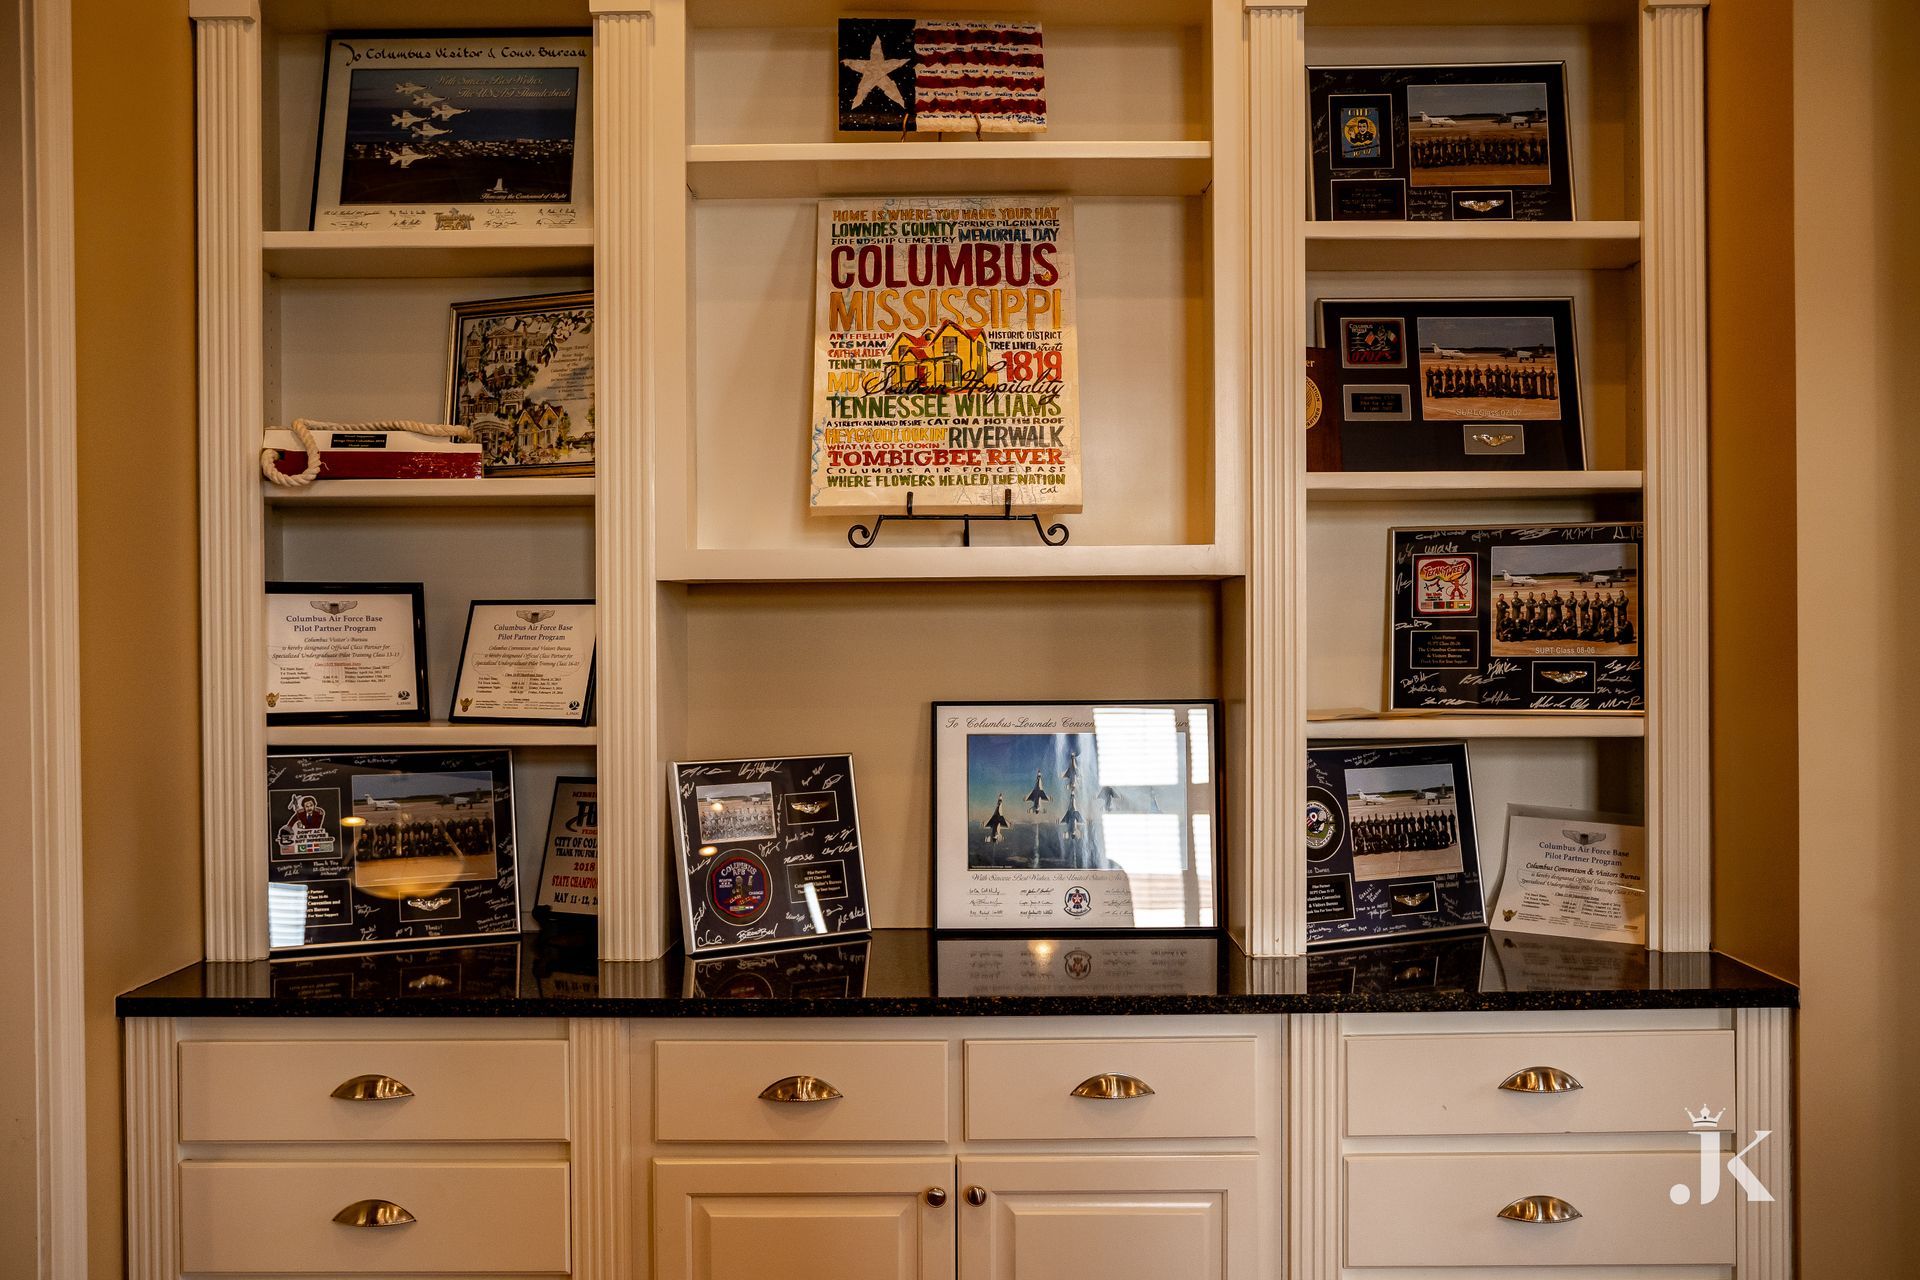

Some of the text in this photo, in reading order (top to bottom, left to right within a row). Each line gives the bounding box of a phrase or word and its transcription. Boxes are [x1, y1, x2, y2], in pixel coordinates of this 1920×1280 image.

[366, 47, 431, 60] Columbus
[436, 47, 482, 59] Visitor
[500, 46, 535, 58] Conv.
[538, 46, 588, 59] Bureau
[833, 207, 1060, 222] HOME IS WHERE YOU HANG YOUR HAT
[832, 221, 958, 238] LOWNDES COUNTY
[958, 228, 1060, 242] MEMORIAL DAY
[831, 236, 957, 245] FRIENDSHIP CEMETERY
[830, 243, 1059, 289] COLUMBUS
[829, 288, 1061, 332] MISSISSIPPI
[988, 331, 1062, 340] HISTORIC DISTRICT
[989, 341, 1063, 351] TREE LINED streets
[861, 348, 888, 357] ALLEY
[828, 359, 882, 370] TENN-TOM
[1001, 351, 1063, 382] 1819
[860, 361, 1064, 405] Southern Hospitality
[826, 394, 1062, 419] TENNESSEE WILLIAMS
[928, 418, 949, 426] CAT
[826, 428, 855, 444] HEY
[855, 428, 895, 443] GOOD
[949, 425, 1064, 449] RIVERWALK
[827, 443, 856, 451] WHAT
[858, 443, 870, 451] YA
[828, 449, 1065, 467] TOMBIGBEE RIVER
[826, 467, 913, 475] COLUMBUS
[963, 466, 1017, 474] FORCE
[1026, 466, 1066, 474] BASE
[827, 473, 1066, 488] WHERE FLOWERS HEALED THE NATION
[286, 615, 383, 623] Columbus Air Force Base
[344, 625, 376, 634] Program
[538, 634, 565, 642] Program
[1556, 646, 1575, 654] Class
[1576, 646, 1595, 654] 08-06
[946, 717, 959, 728] To
[966, 716, 1057, 728] Columbus-Lowndes
[554, 836, 572, 847] CITY
[572, 837, 582, 847] OF
[555, 848, 573, 857] THANK
[574, 849, 585, 857] YOU
[1539, 842, 1576, 852] Columbus
[1591, 848, 1610, 856] Force
[1613, 850, 1629, 858] Base
[1545, 852, 1622, 867] Pilot Partner Program
[573, 862, 595, 871] 2018
[721, 862, 757, 876] COLUMBUS
[1526, 862, 1553, 871] Columbus
[1554, 866, 1588, 875] Convention
[1595, 870, 1618, 878] Visitors
[552, 875, 570, 887] STATE
[554, 892, 569, 903] MAY
